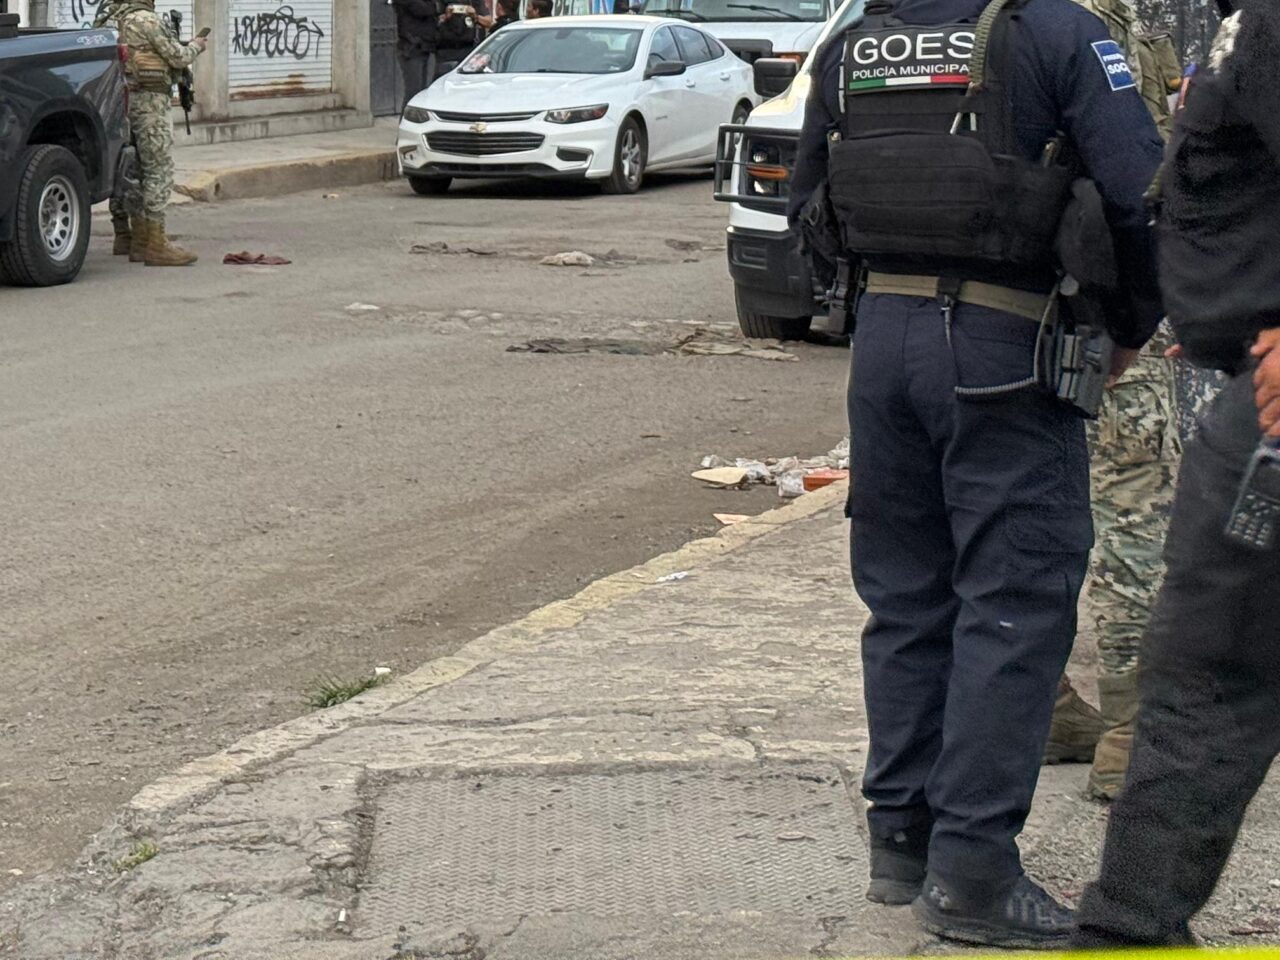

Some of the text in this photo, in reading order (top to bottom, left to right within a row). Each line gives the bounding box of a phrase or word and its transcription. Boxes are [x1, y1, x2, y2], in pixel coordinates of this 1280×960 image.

[852, 31, 976, 65] GOES
[852, 63, 970, 80] POLICÍA MUNICIPA
